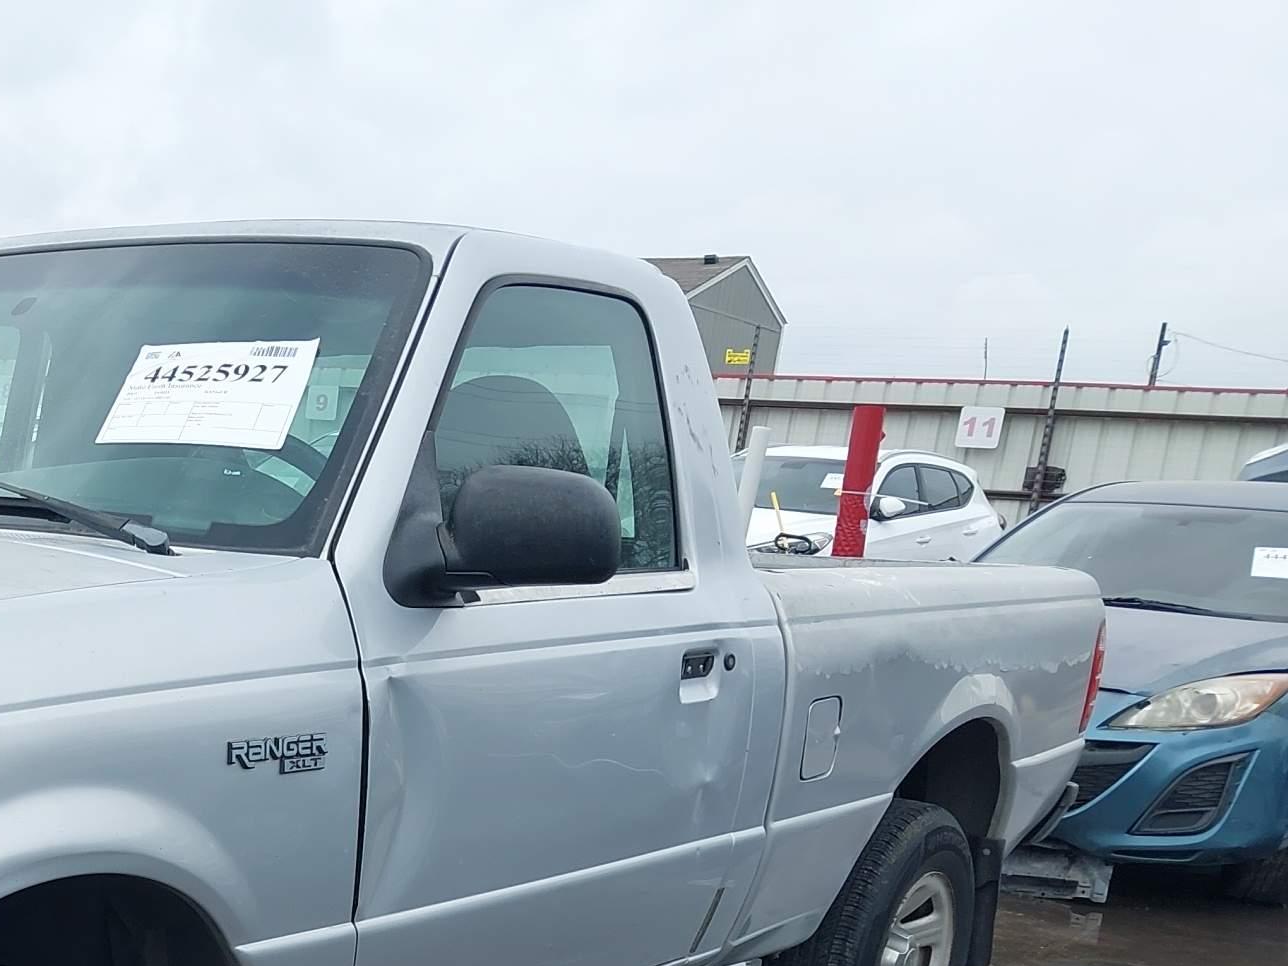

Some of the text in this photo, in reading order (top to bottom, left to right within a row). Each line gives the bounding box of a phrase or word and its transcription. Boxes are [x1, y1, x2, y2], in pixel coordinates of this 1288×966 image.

[144, 363, 289, 384] 44525927
[315, 394, 329, 412] 9
[963, 416, 996, 438] 11
[226, 732, 329, 770] RANGER
[287, 756, 323, 771] XLT
